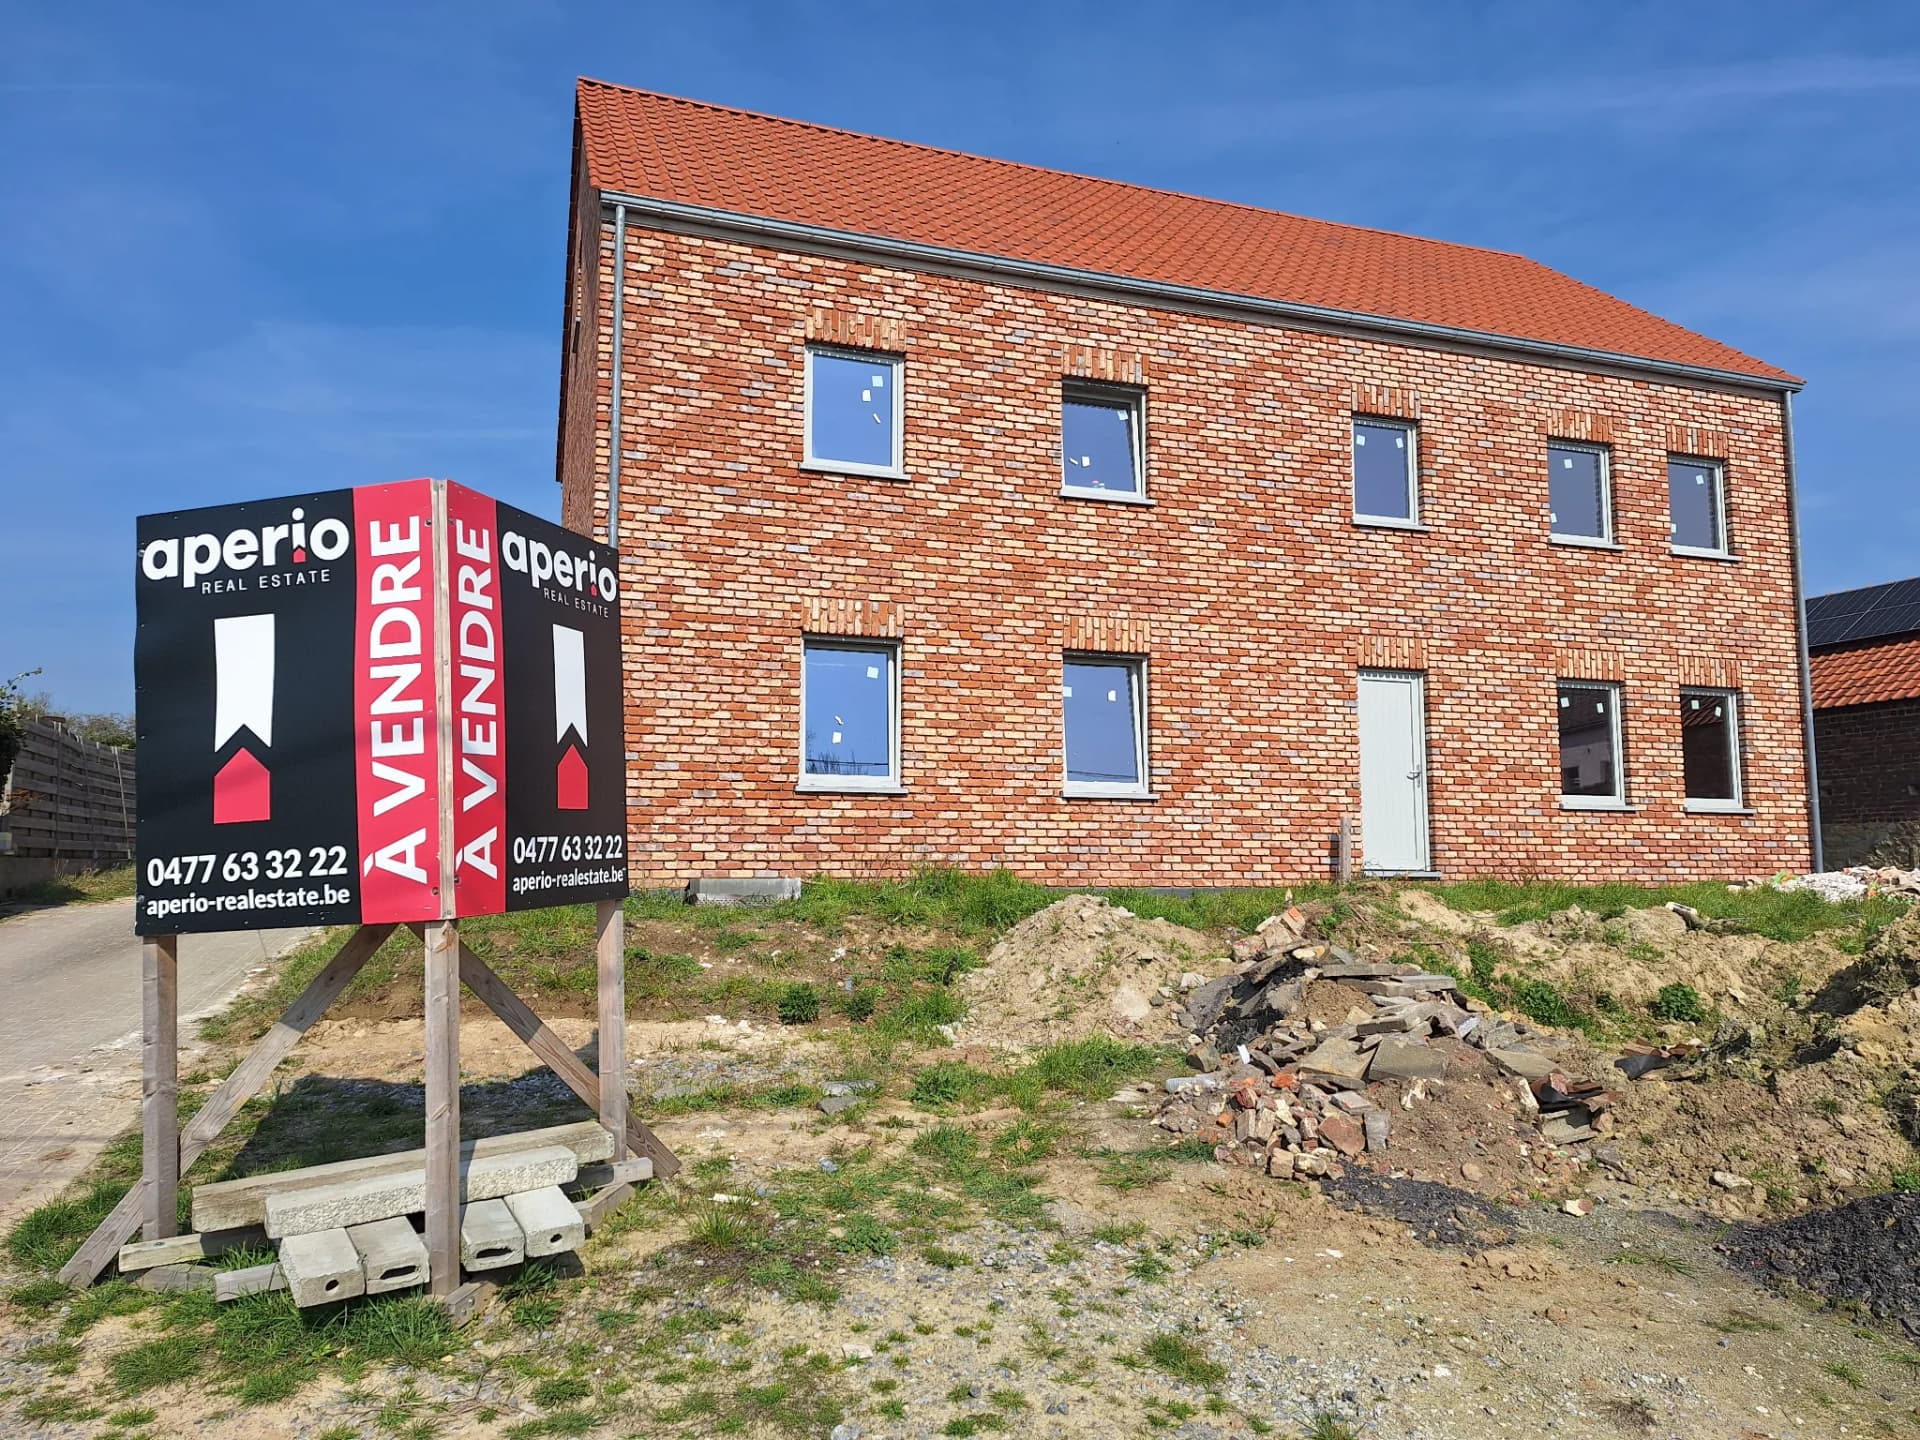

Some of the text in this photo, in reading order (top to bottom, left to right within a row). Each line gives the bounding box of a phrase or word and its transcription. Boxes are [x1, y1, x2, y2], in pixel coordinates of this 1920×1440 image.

[142, 507, 350, 588] aperio
[501, 531, 617, 602] aperio
[201, 569, 331, 595] REAL ESTATE
[543, 587, 609, 618] REAL ESTATE
[363, 515, 428, 884] À VENDRE
[456, 518, 498, 881] À VENDRE
[146, 845, 348, 887] 0477 63 32 22
[513, 834, 623, 864] 0477 63 32 22
[512, 865, 624, 895] aperio-realestate.be
[146, 883, 351, 918] aperio-realestate.be
